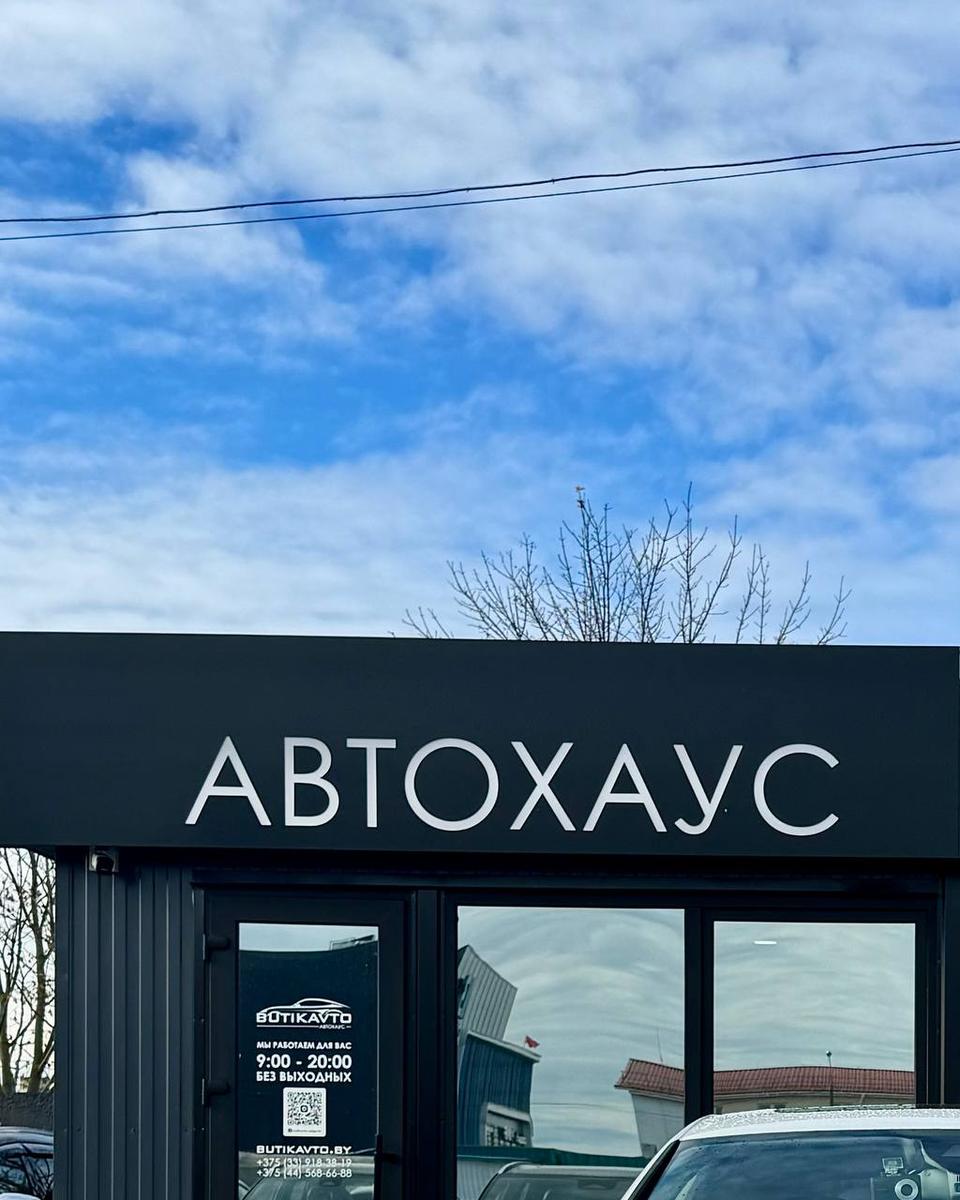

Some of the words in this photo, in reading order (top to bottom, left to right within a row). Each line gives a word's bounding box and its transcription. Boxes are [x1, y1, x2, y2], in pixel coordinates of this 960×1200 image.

[185, 735, 839, 836] АВТОХАУС
[256, 1012, 352, 1024] BUTIKAVTO
[316, 1042, 333, 1050] ДЛЯ
[335, 1042, 352, 1050] ВАС
[256, 1054, 290, 1068] 9:00
[308, 1054, 352, 1068] 20:00
[256, 1072, 276, 1082] БЕЗ
[280, 1072, 352, 1083] ВЫХОДНЫХ
[256, 1145, 352, 1154] BUTIKAVTO.BY
[256, 1158, 280, 1167] +375
[283, 1158, 302, 1168] (33)
[305, 1158, 352, 1167] 918-38-19
[256, 1168, 280, 1178] +375
[283, 1168, 302, 1178] (44)
[305, 1168, 352, 1178] 568-66-88
